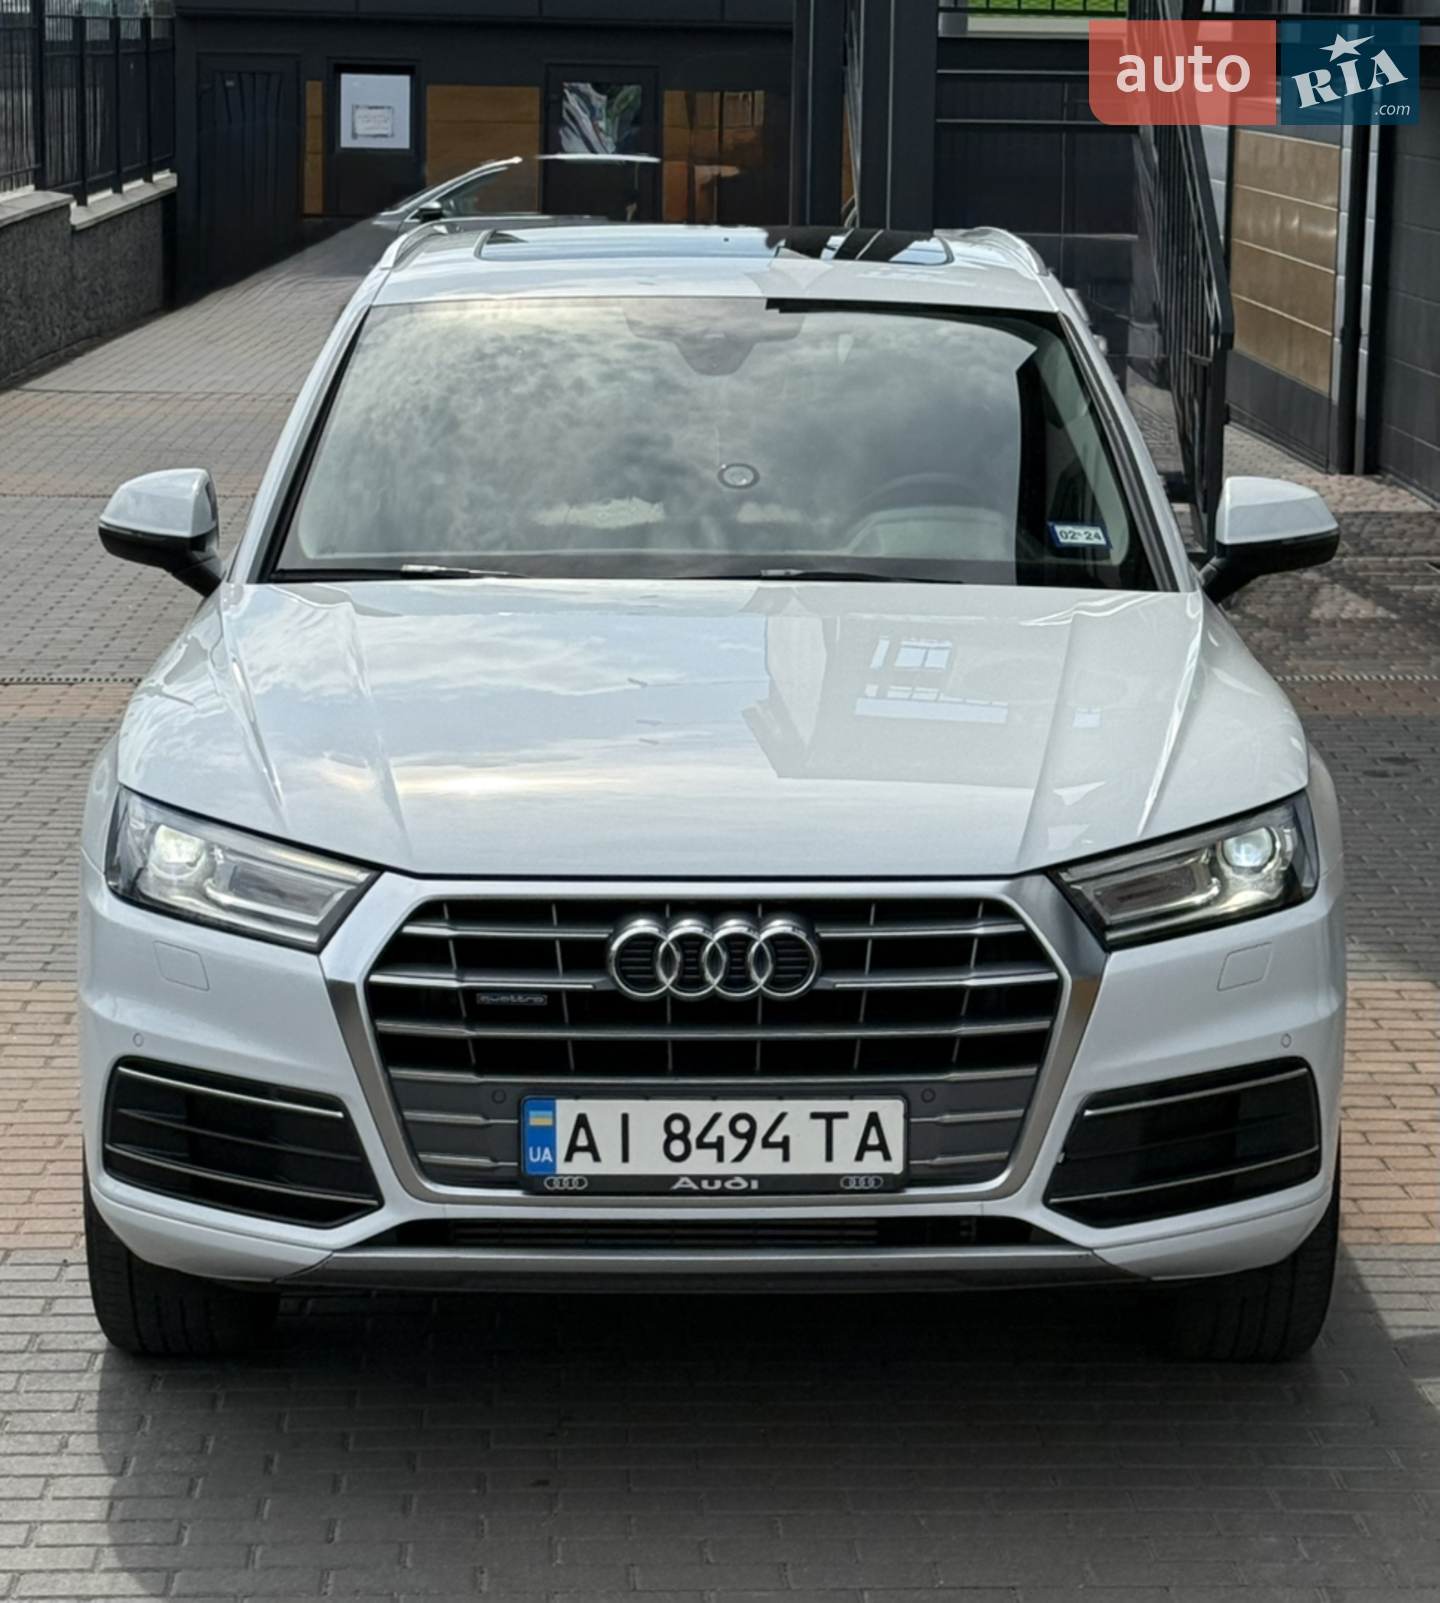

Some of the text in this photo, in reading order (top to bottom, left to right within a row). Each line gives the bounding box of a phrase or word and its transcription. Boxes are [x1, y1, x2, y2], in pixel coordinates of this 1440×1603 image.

[662, 1112, 791, 1163] 8494
[809, 1111, 893, 1163] TA
[528, 1146, 554, 1163] UA
[670, 1176, 759, 1190] Audi
